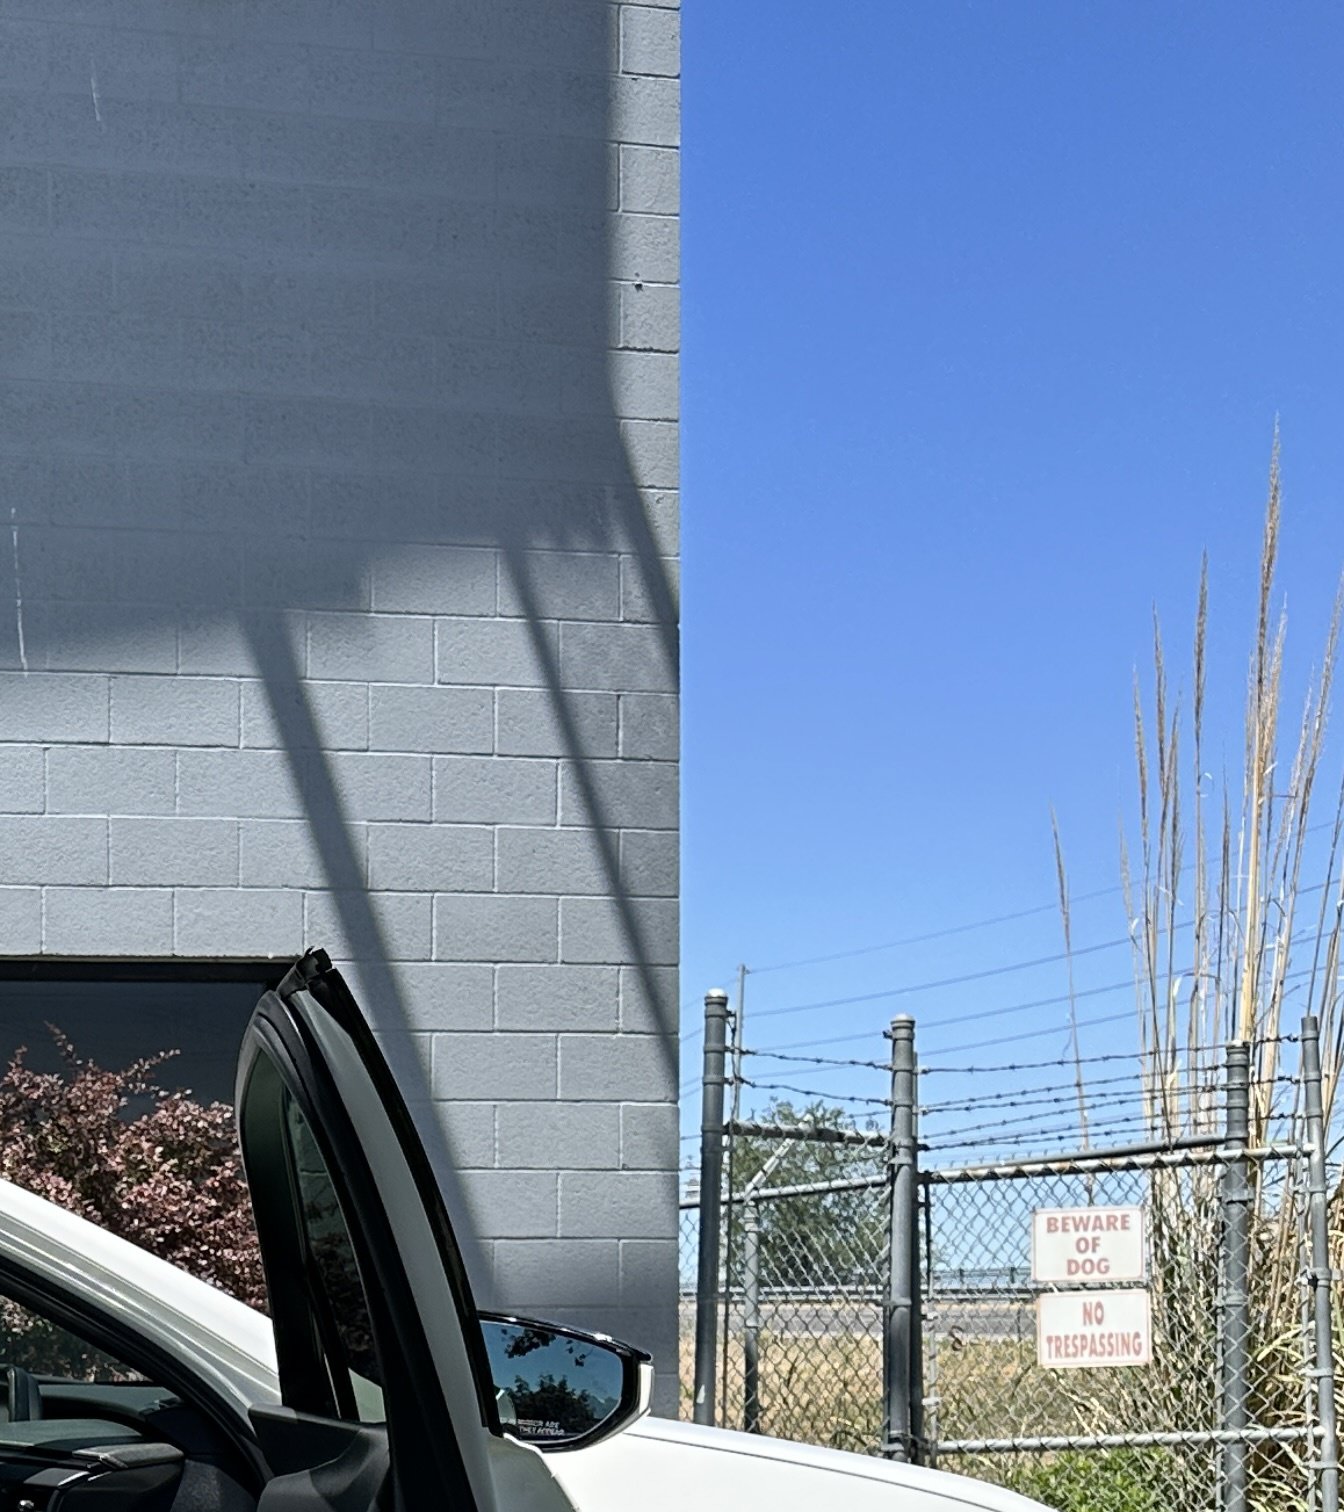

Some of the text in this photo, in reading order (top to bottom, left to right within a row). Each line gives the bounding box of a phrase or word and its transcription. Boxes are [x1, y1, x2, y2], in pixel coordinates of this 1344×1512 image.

[1046, 1214, 1130, 1233] BEWARE
[1075, 1236, 1102, 1255] OF
[1066, 1257, 1111, 1276] DOG
[1082, 1300, 1105, 1327] NO
[1046, 1331, 1143, 1360] TRESPASSING
